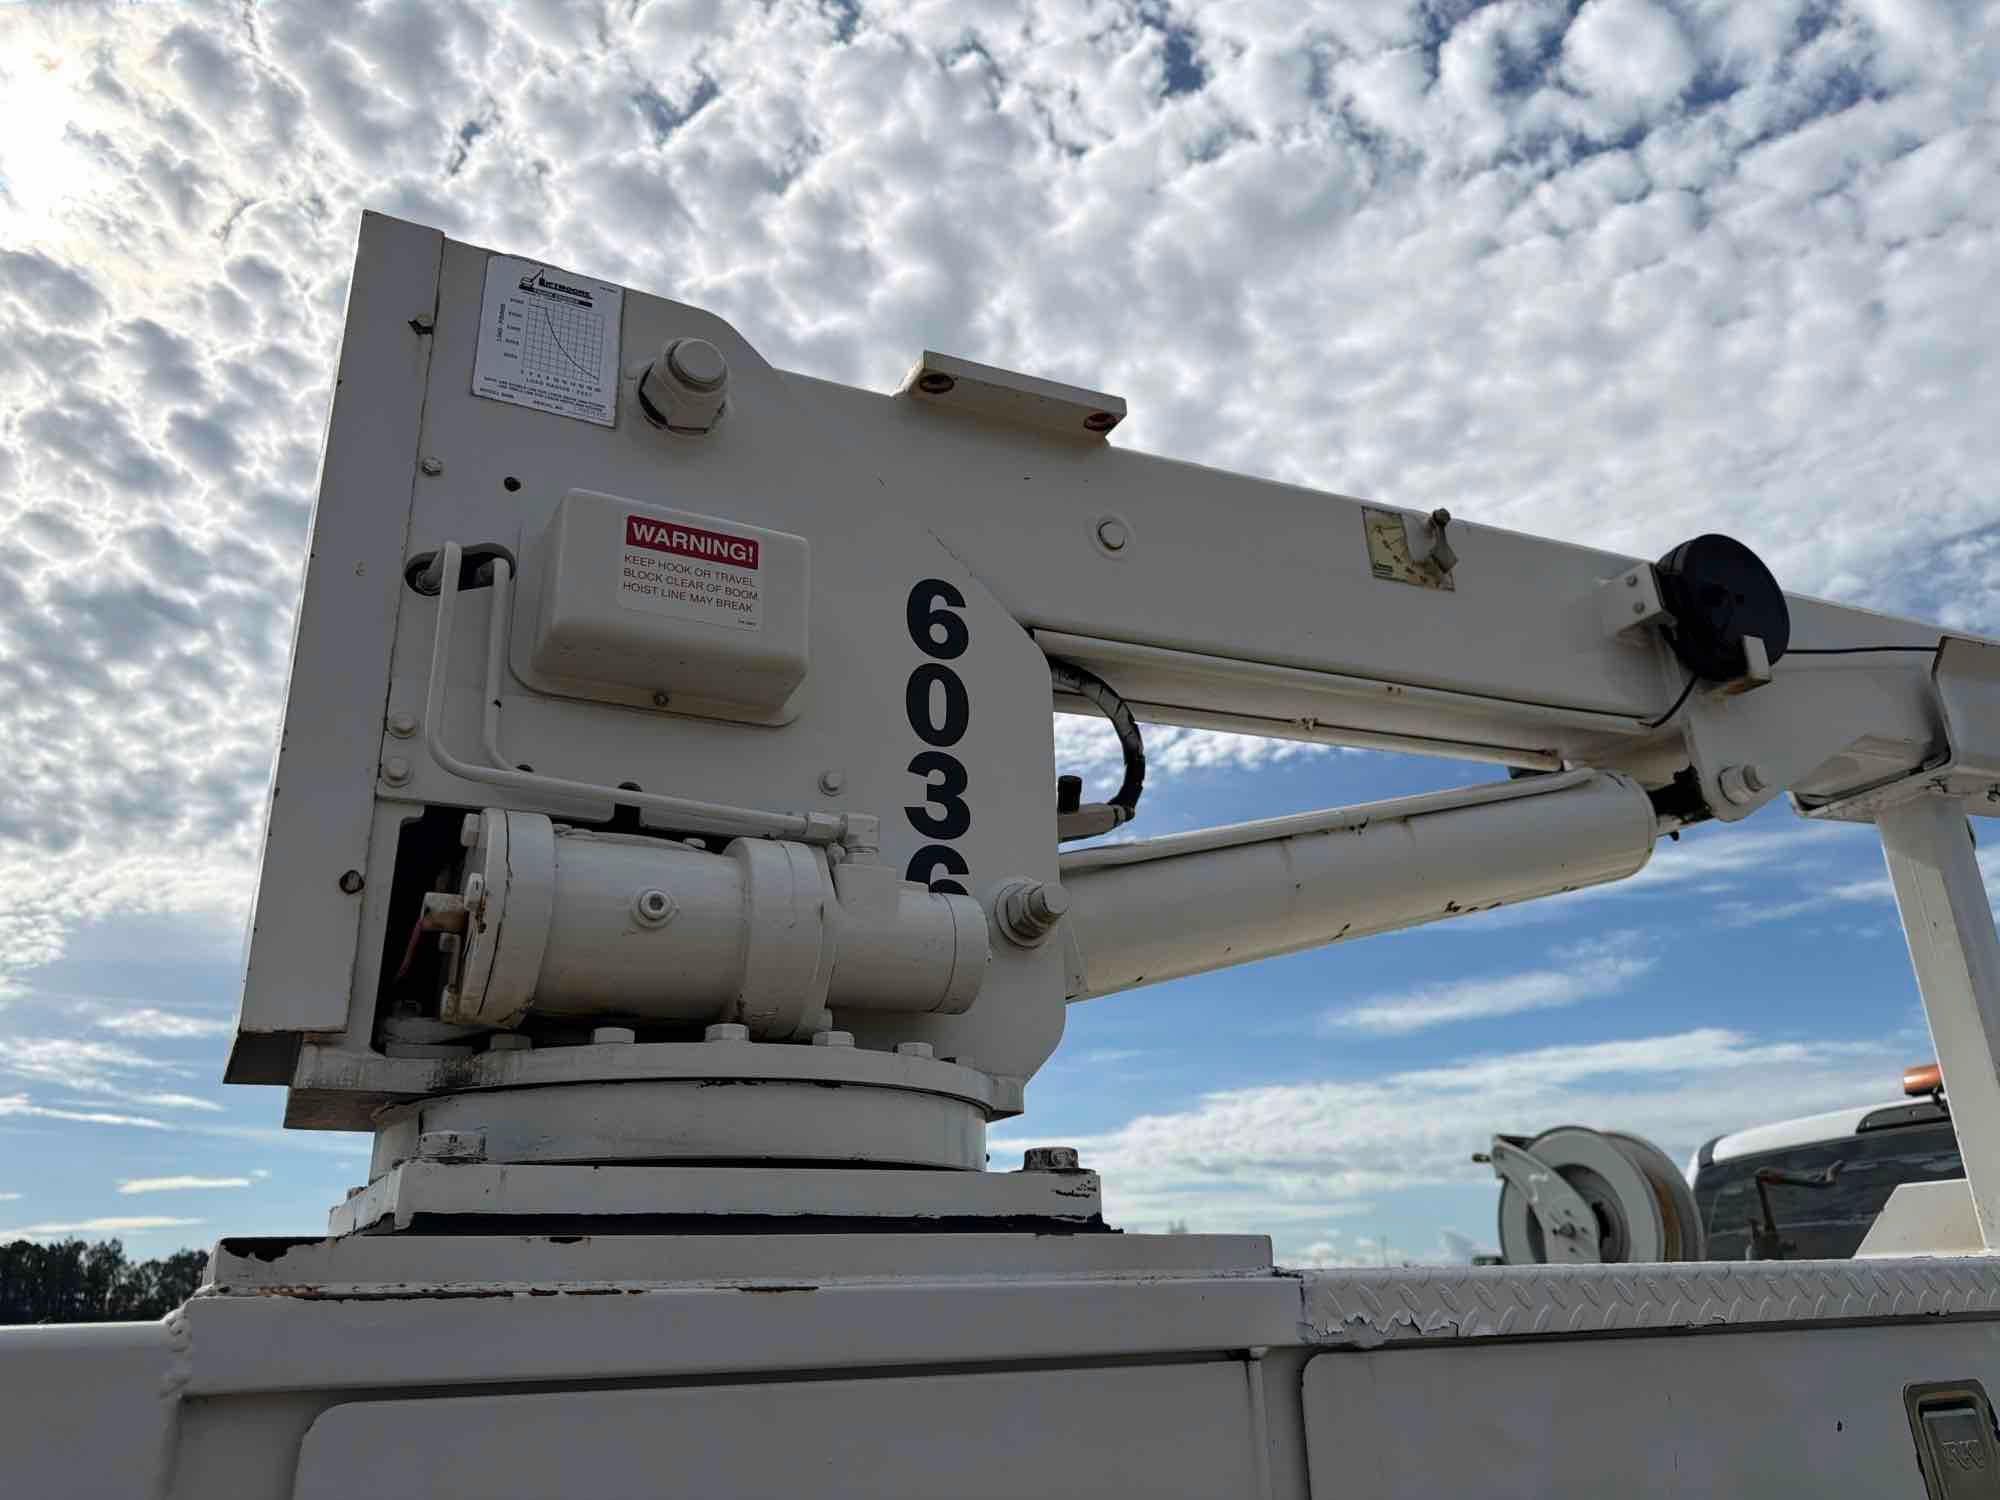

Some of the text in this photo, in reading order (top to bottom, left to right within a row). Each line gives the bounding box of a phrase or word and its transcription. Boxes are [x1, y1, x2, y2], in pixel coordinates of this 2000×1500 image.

[632, 522, 754, 563] WARNING!
[624, 554, 754, 587] KEEP HOOK OR TRAVEL
[624, 567, 758, 600] BLOCK CLEAR OF BOOM
[623, 580, 753, 613] HOIST LINE MAY BREAK
